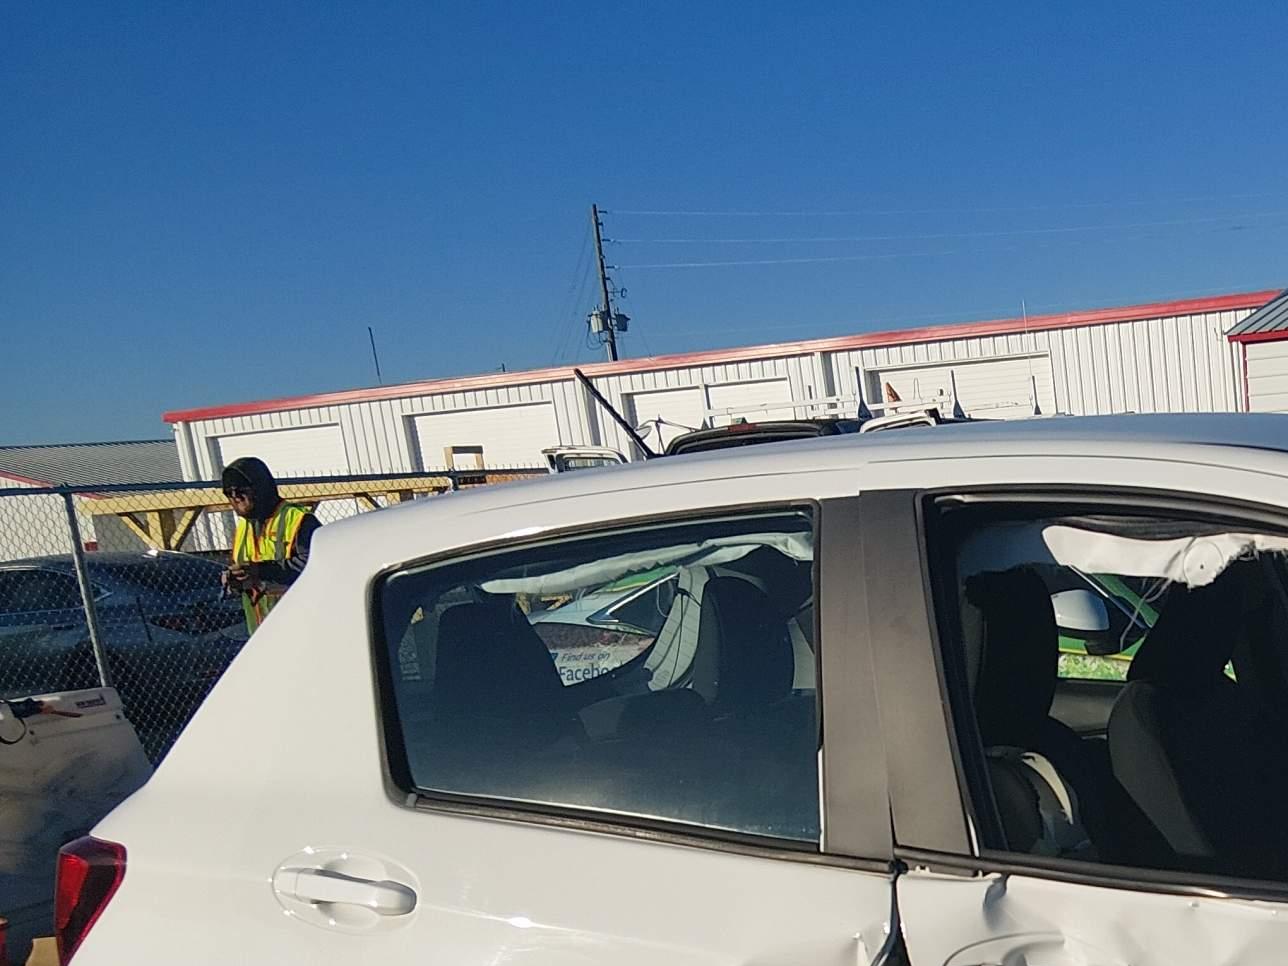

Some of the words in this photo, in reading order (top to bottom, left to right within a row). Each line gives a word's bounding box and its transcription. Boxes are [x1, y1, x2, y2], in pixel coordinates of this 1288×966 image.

[562, 652, 583, 661] Find
[583, 653, 594, 661] us
[597, 652, 610, 661] on
[558, 663, 612, 682] Facebo
